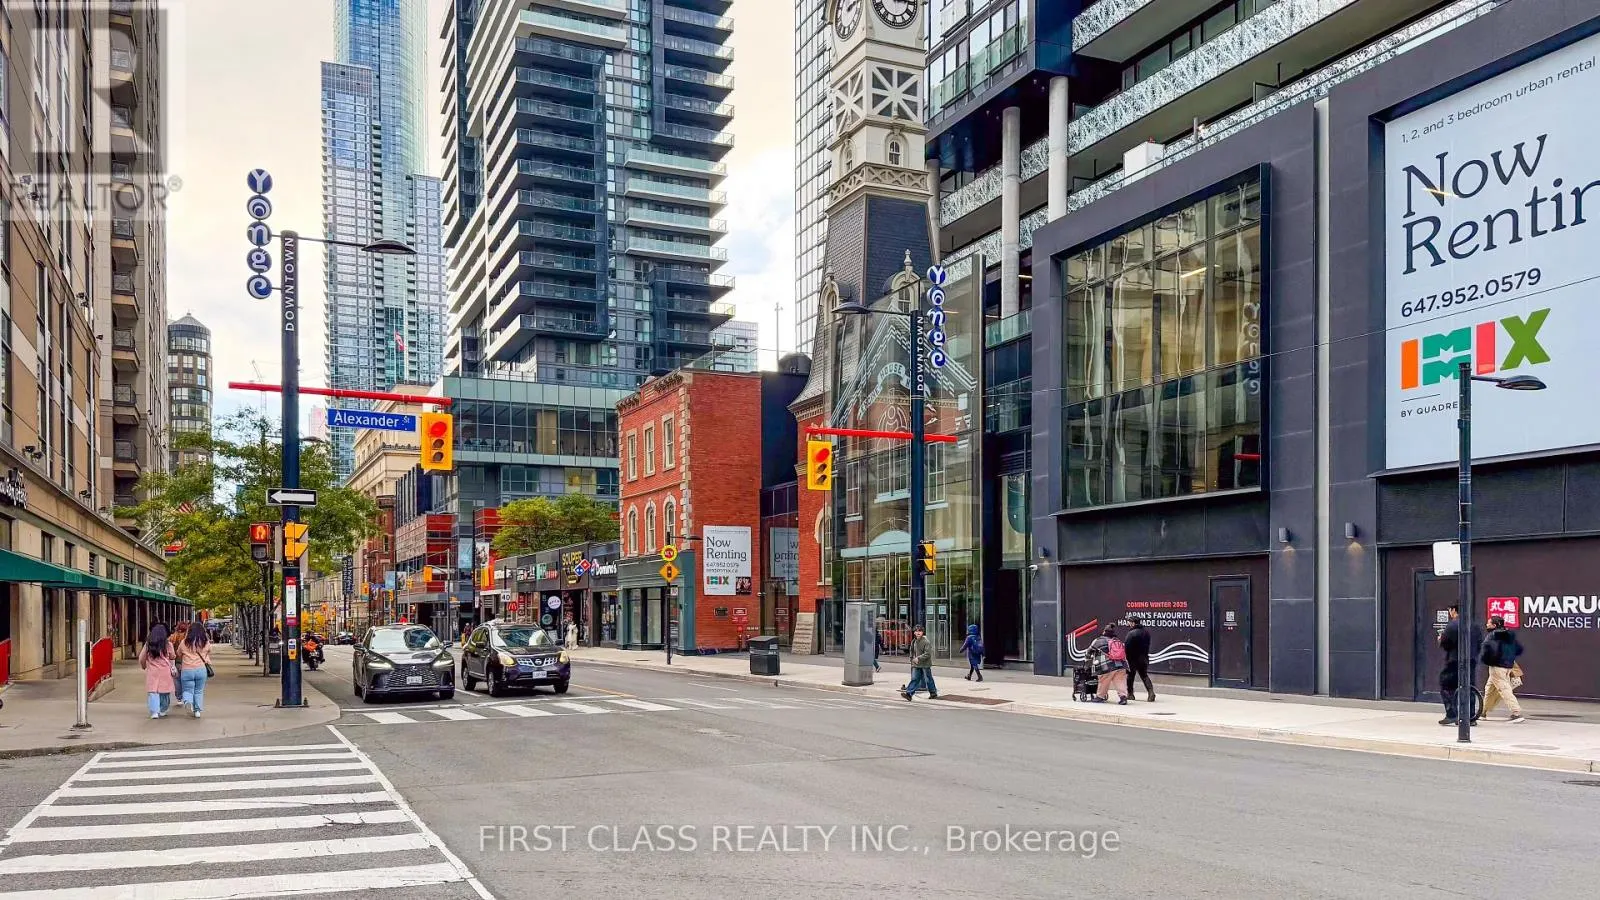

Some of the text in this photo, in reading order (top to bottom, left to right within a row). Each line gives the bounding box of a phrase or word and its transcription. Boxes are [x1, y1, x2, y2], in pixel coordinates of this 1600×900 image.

[1411, 129, 1420, 140] 2,
[1423, 118, 1444, 135] and
[1447, 114, 1454, 125] 3
[1457, 92, 1512, 121] bedroom
[1516, 76, 1553, 97] urban
[1557, 56, 1596, 81] rental
[1402, 133, 1548, 219] Now
[247, 169, 272, 300] Yonge
[285, 237, 295, 332] DOWNTOWN
[1401, 267, 1542, 318] 647.952.0579
[927, 264, 946, 369] Yonge
[334, 411, 410, 428] Alexander St
[1401, 410, 1413, 418] BY
[706, 536, 731, 548] Now
[706, 547, 747, 562] Renting
[596, 560, 617, 576] Domino's
[1523, 596, 1600, 614] MARU
[1117, 619, 1205, 628] HAADE UDON HOUSE
[1125, 611, 1193, 620] JAPAN'S FAVOURITE
[1524, 616, 1592, 629] JAPANESE
